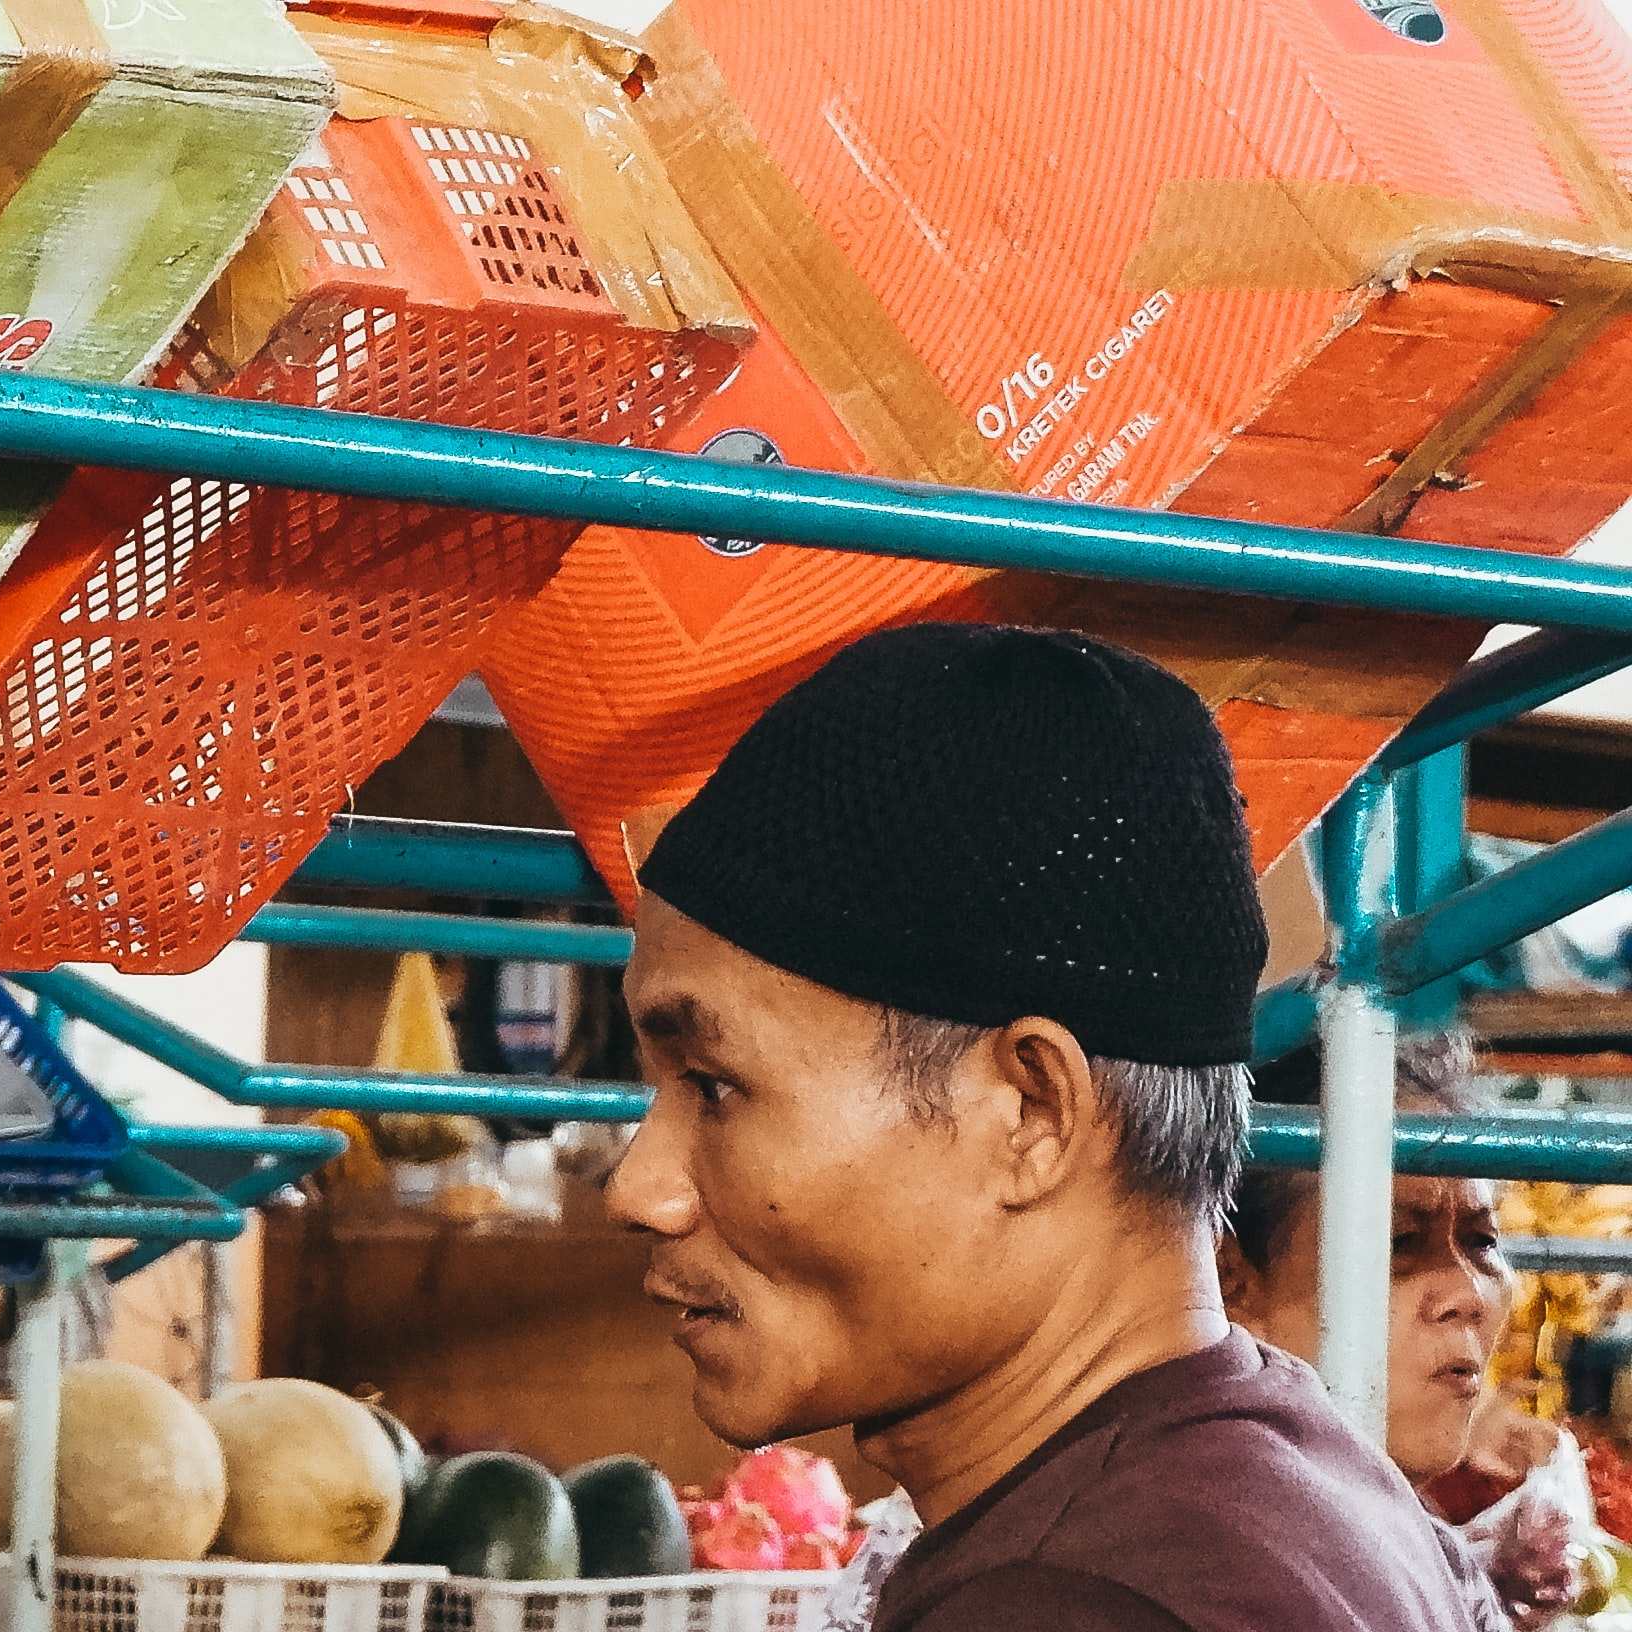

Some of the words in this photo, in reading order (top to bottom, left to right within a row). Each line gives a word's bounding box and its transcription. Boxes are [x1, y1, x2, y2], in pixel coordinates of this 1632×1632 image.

[1005, 376, 1088, 464] KRETEK
[1073, 431, 1099, 458] BY
[1067, 439, 1126, 501] GARAM
